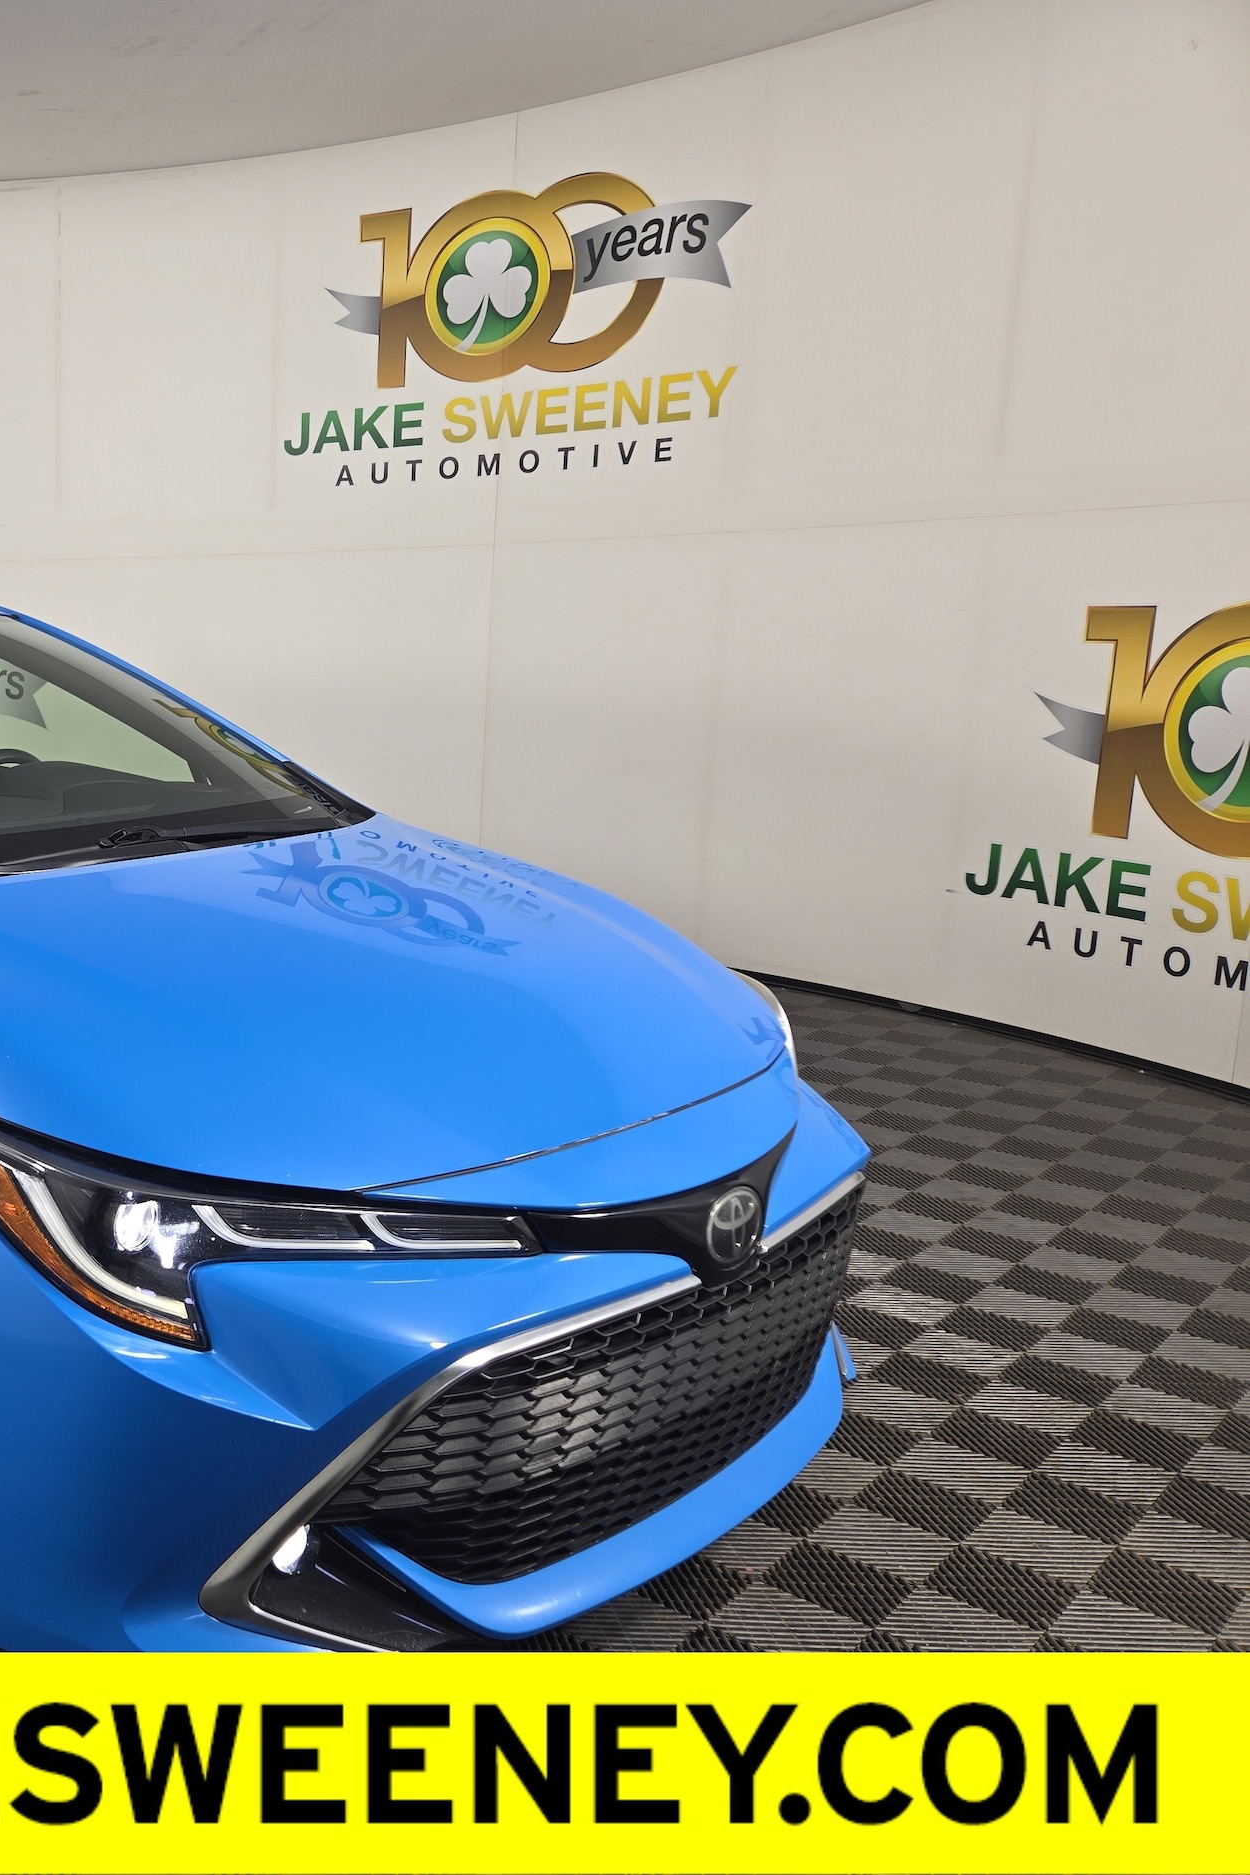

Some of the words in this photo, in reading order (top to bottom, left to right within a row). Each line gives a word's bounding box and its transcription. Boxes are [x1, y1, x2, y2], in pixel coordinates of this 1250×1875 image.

[582, 212, 710, 284] years
[284, 402, 425, 456] JAKE
[441, 365, 739, 444] SWEENEY
[335, 437, 674, 487] AUTOMOTIVE
[965, 842, 1152, 922] JAKE
[1026, 920, 1249, 992] AUTOM
